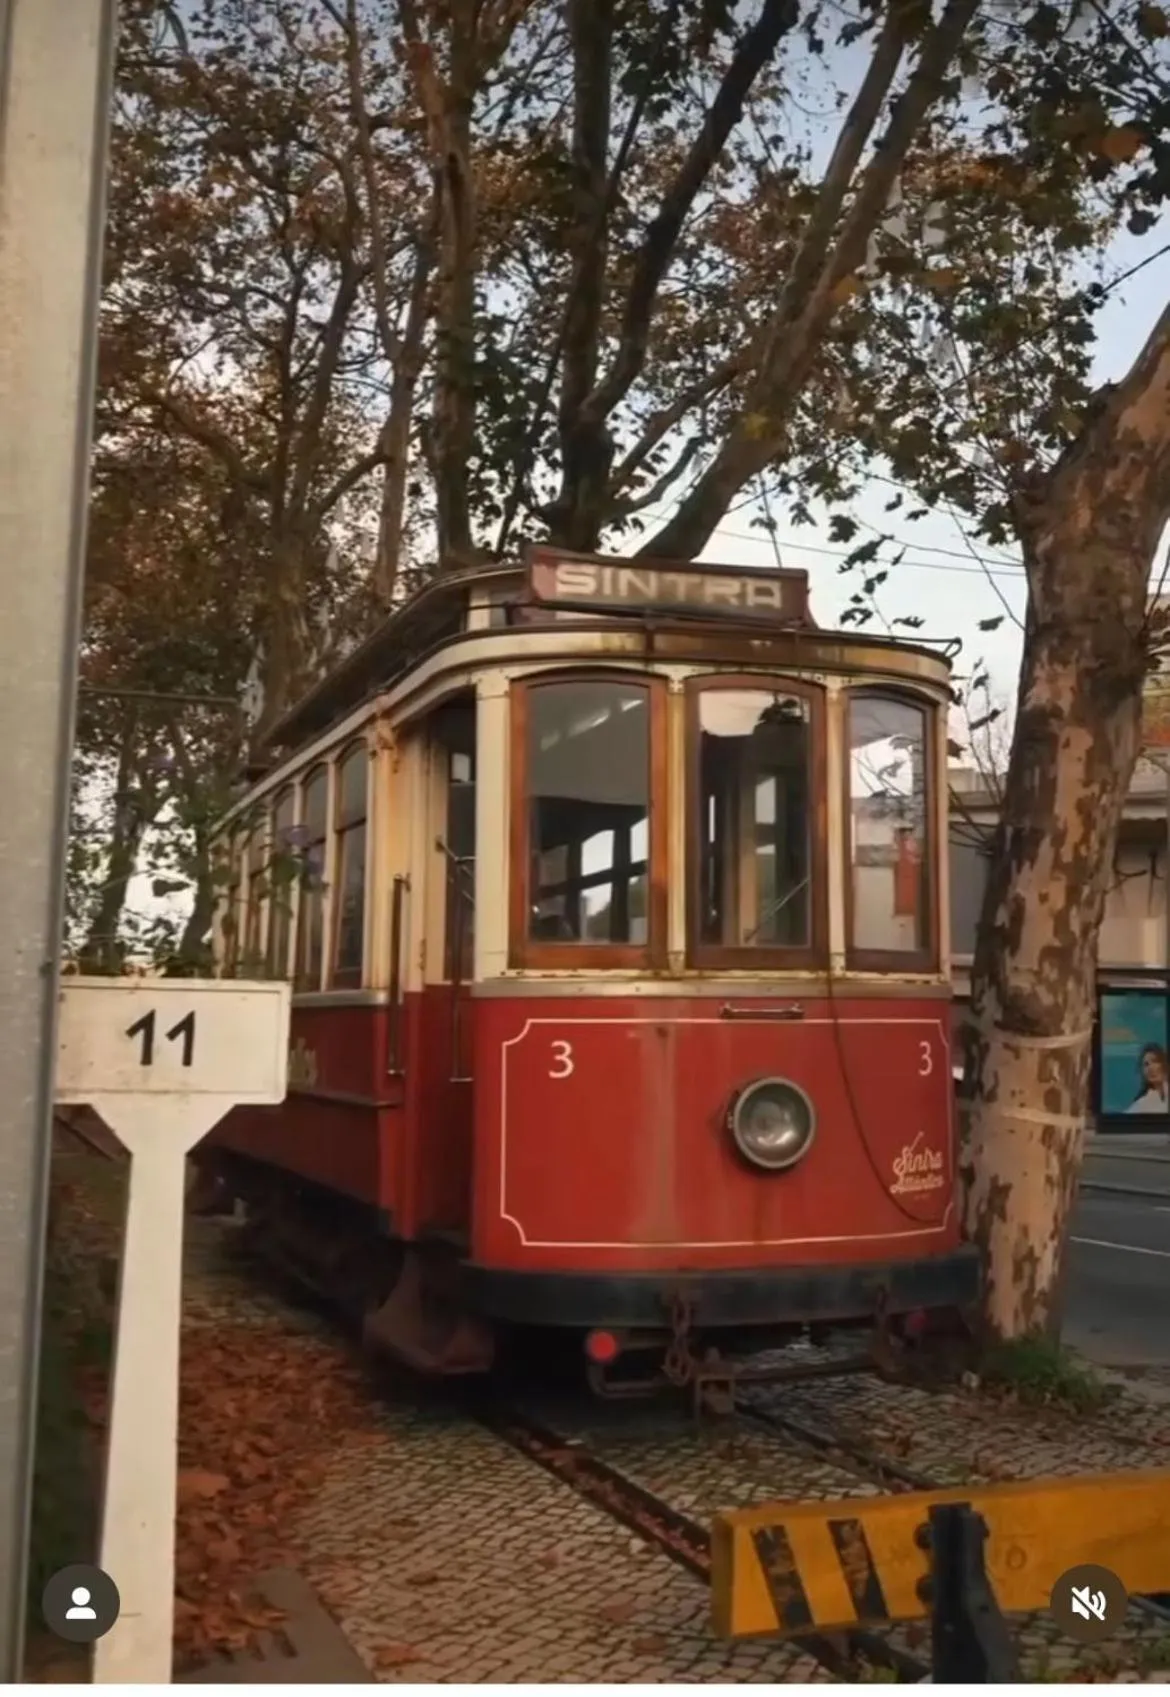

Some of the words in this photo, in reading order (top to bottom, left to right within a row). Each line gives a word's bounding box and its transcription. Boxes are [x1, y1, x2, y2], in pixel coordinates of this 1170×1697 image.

[555, 563, 783, 609] SINTRA
[125, 1008, 196, 1067] 11
[918, 1040, 933, 1076] 3
[549, 1040, 574, 1078] 3
